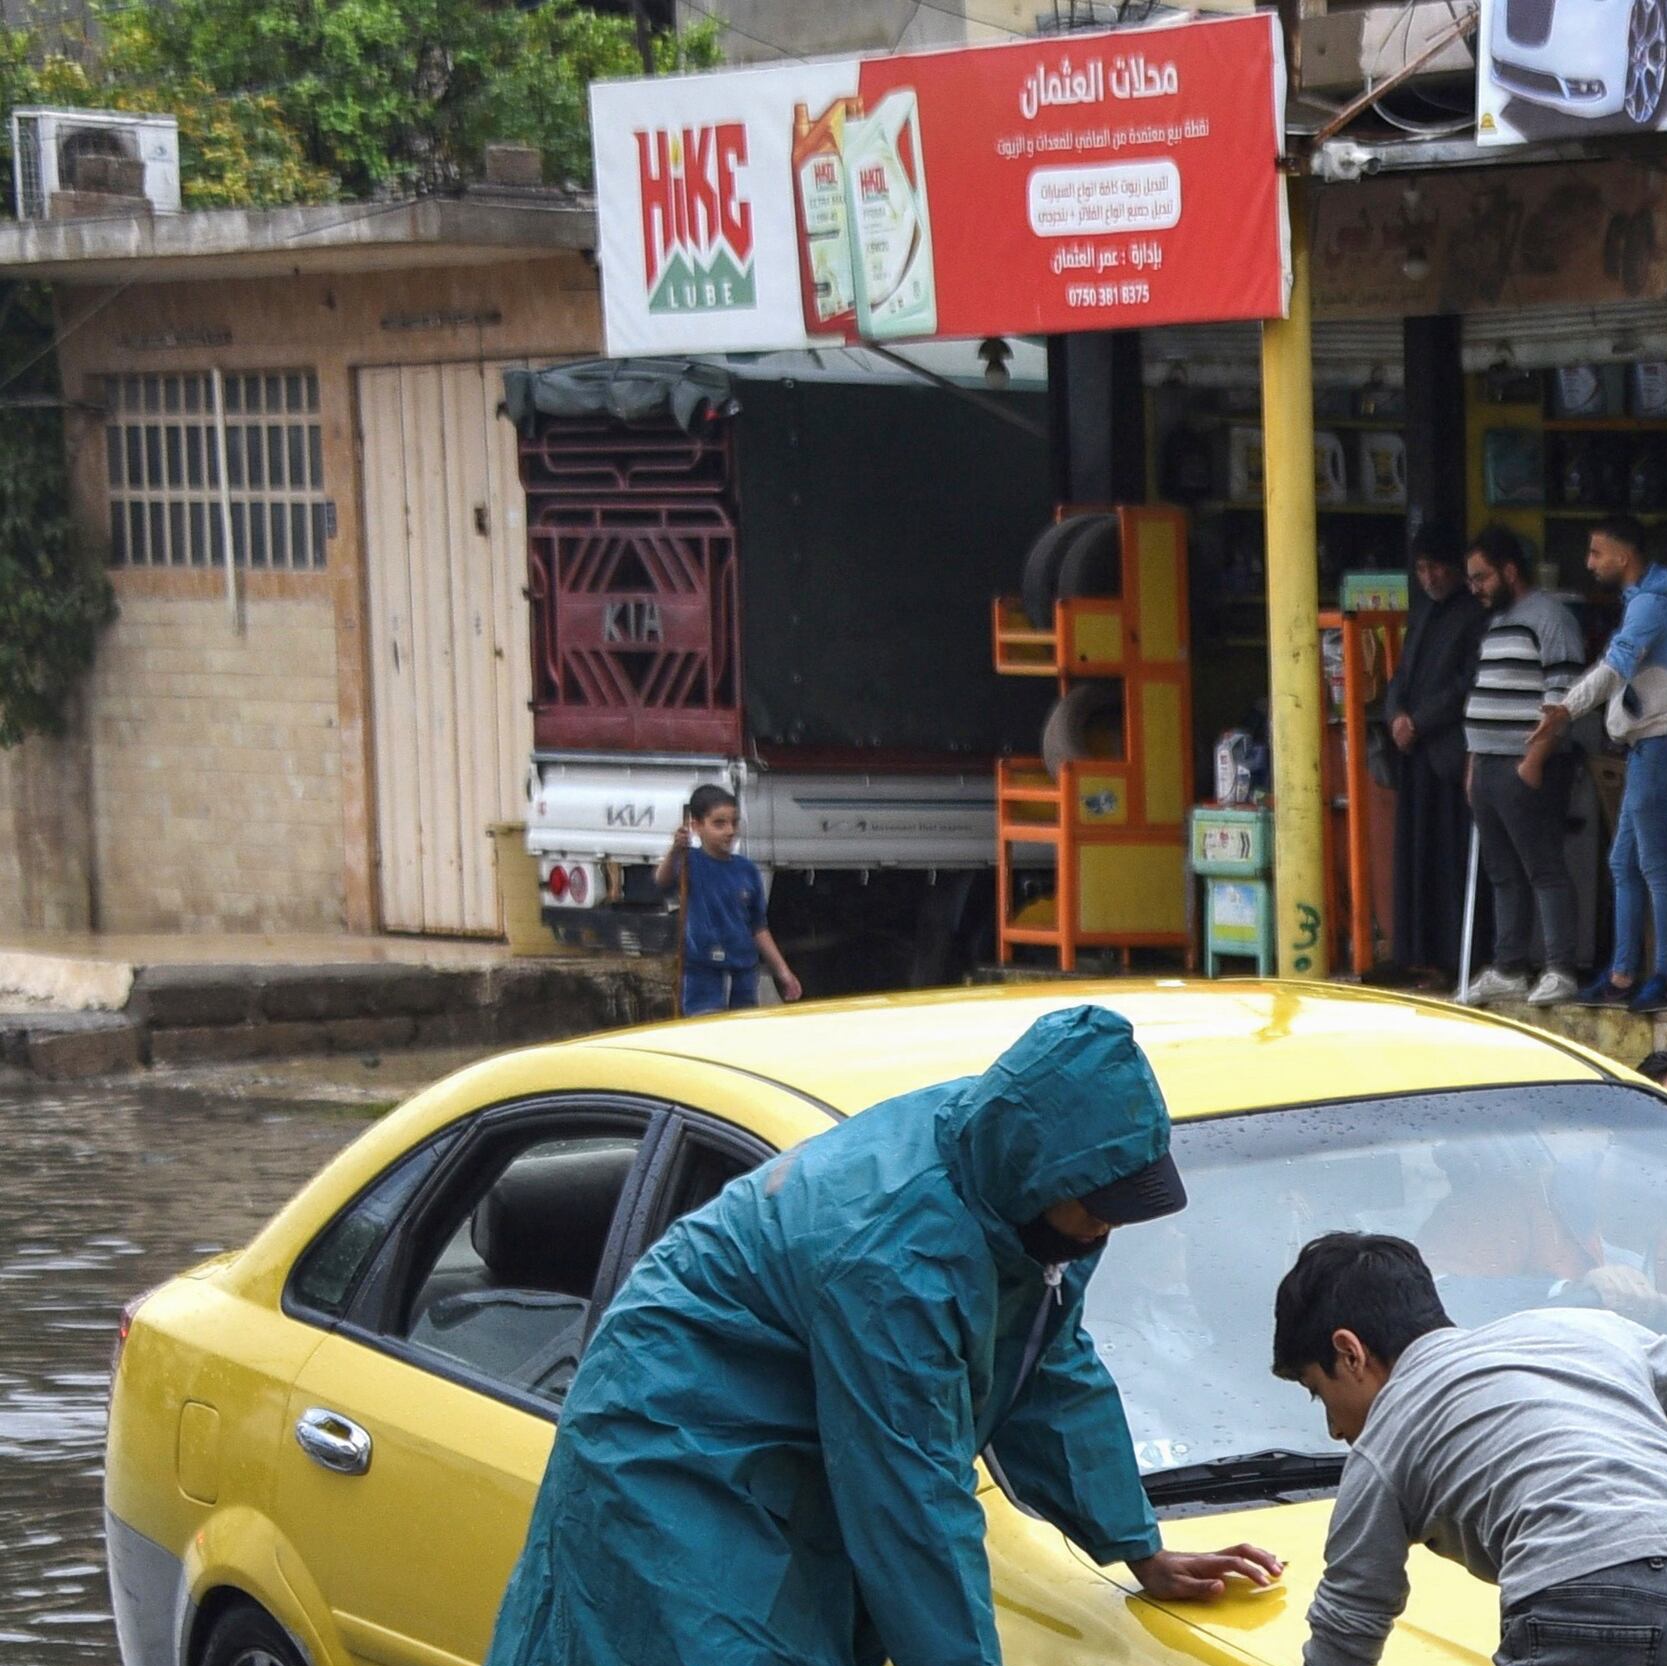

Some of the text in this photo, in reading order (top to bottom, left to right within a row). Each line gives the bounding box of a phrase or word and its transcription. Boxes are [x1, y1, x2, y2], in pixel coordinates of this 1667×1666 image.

[1020, 52, 1179, 120] محلات العثمان
[1129, 127, 1165, 145] معتمدة
[1167, 127, 1183, 146] بيع
[1184, 118, 1209, 138] نقطة
[1113, 132, 1127, 150] من
[1053, 243, 1095, 275] العثمان
[1098, 251, 1119, 273] عمر
[669, 282, 734, 309] LUBE
[1068, 281, 1150, 307] 0750 381 8375
[603, 602, 664, 643] KIA
